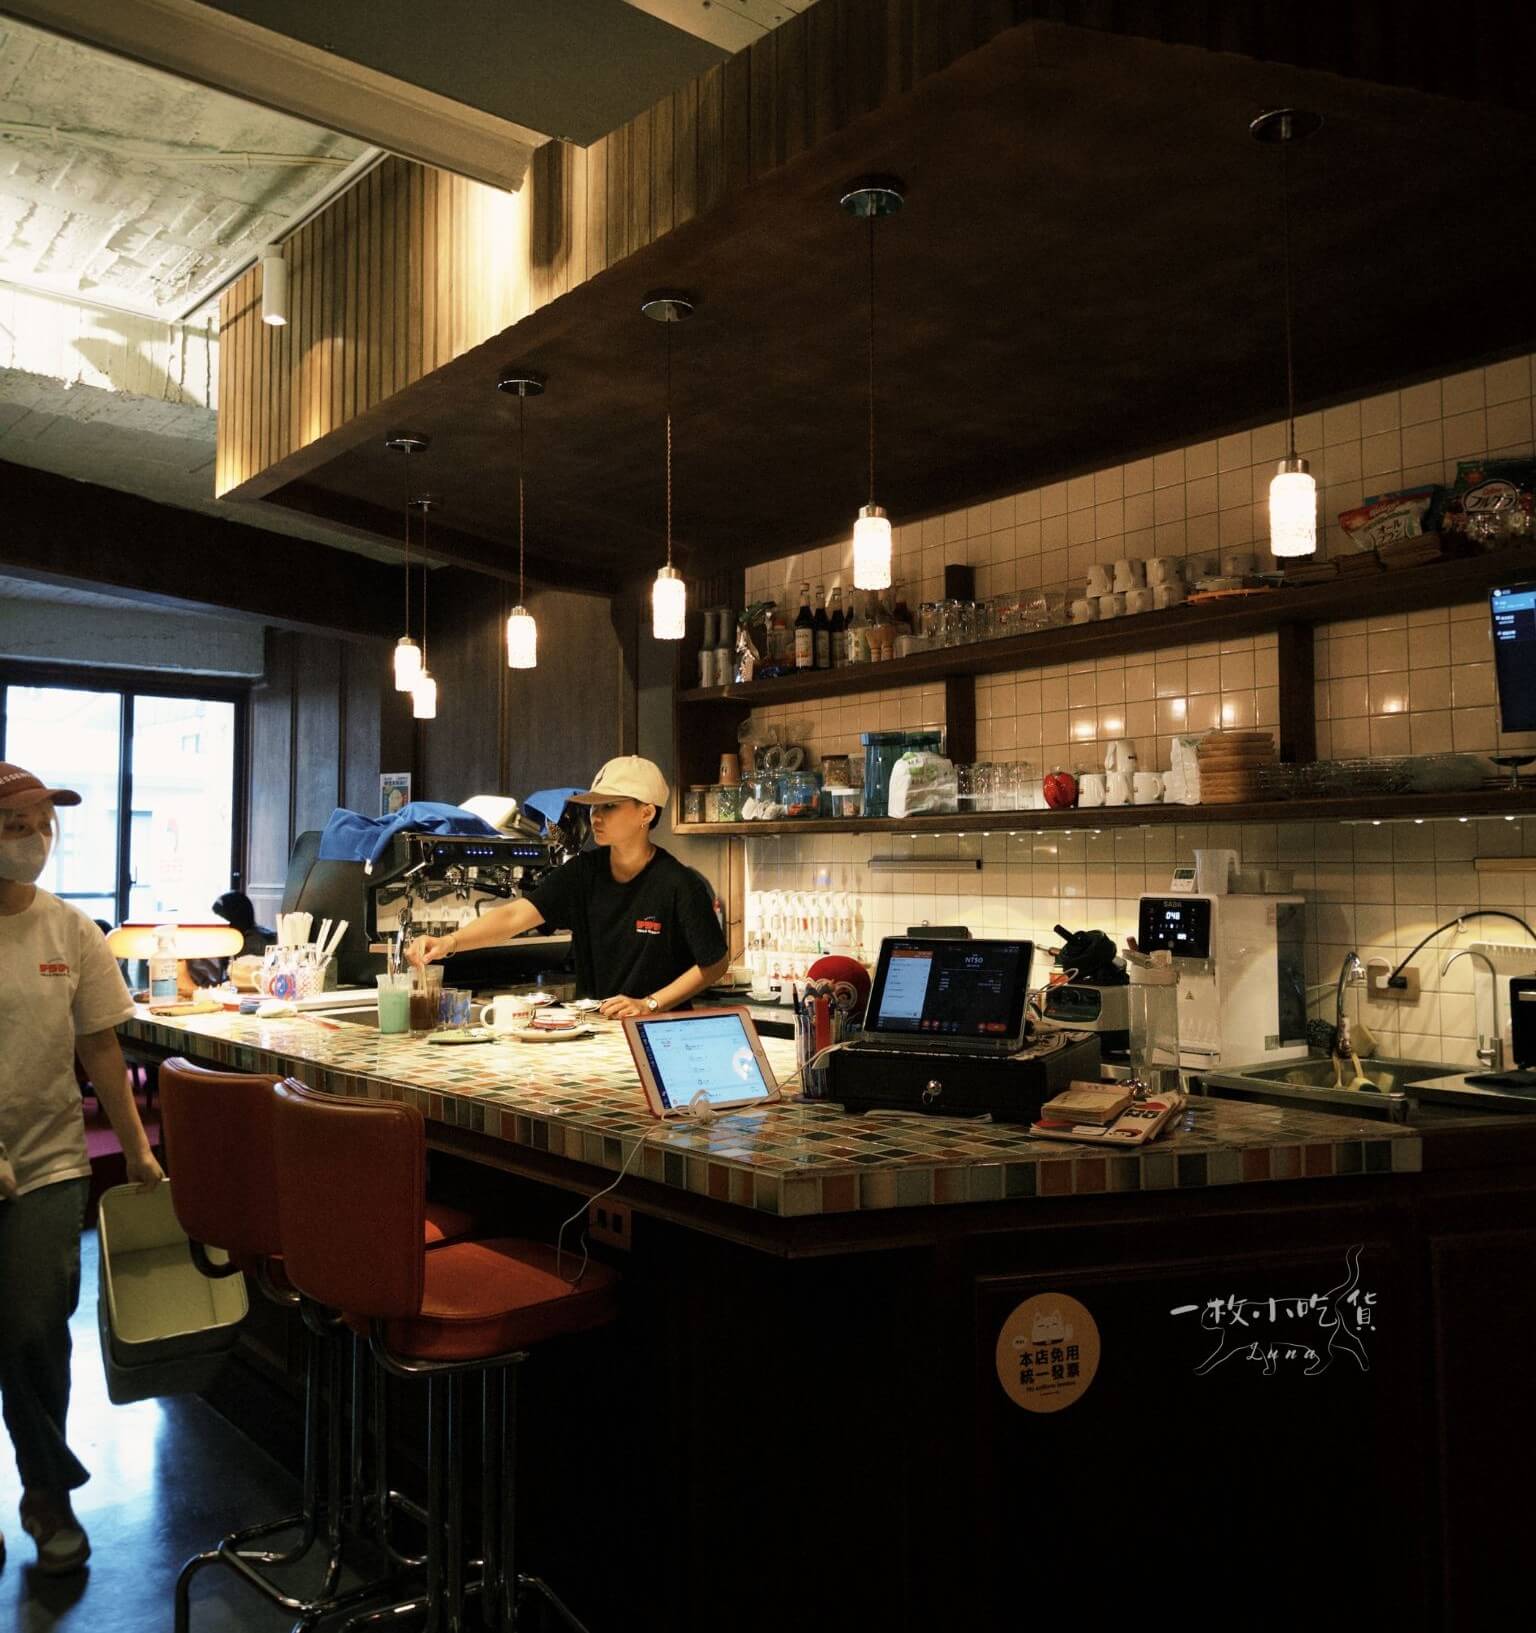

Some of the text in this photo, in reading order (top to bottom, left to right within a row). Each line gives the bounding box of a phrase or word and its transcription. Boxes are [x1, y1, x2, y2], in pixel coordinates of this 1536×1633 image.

[1020, 1345, 1079, 1367] 本店免用
[1020, 1362, 1080, 1385] 統一發票
